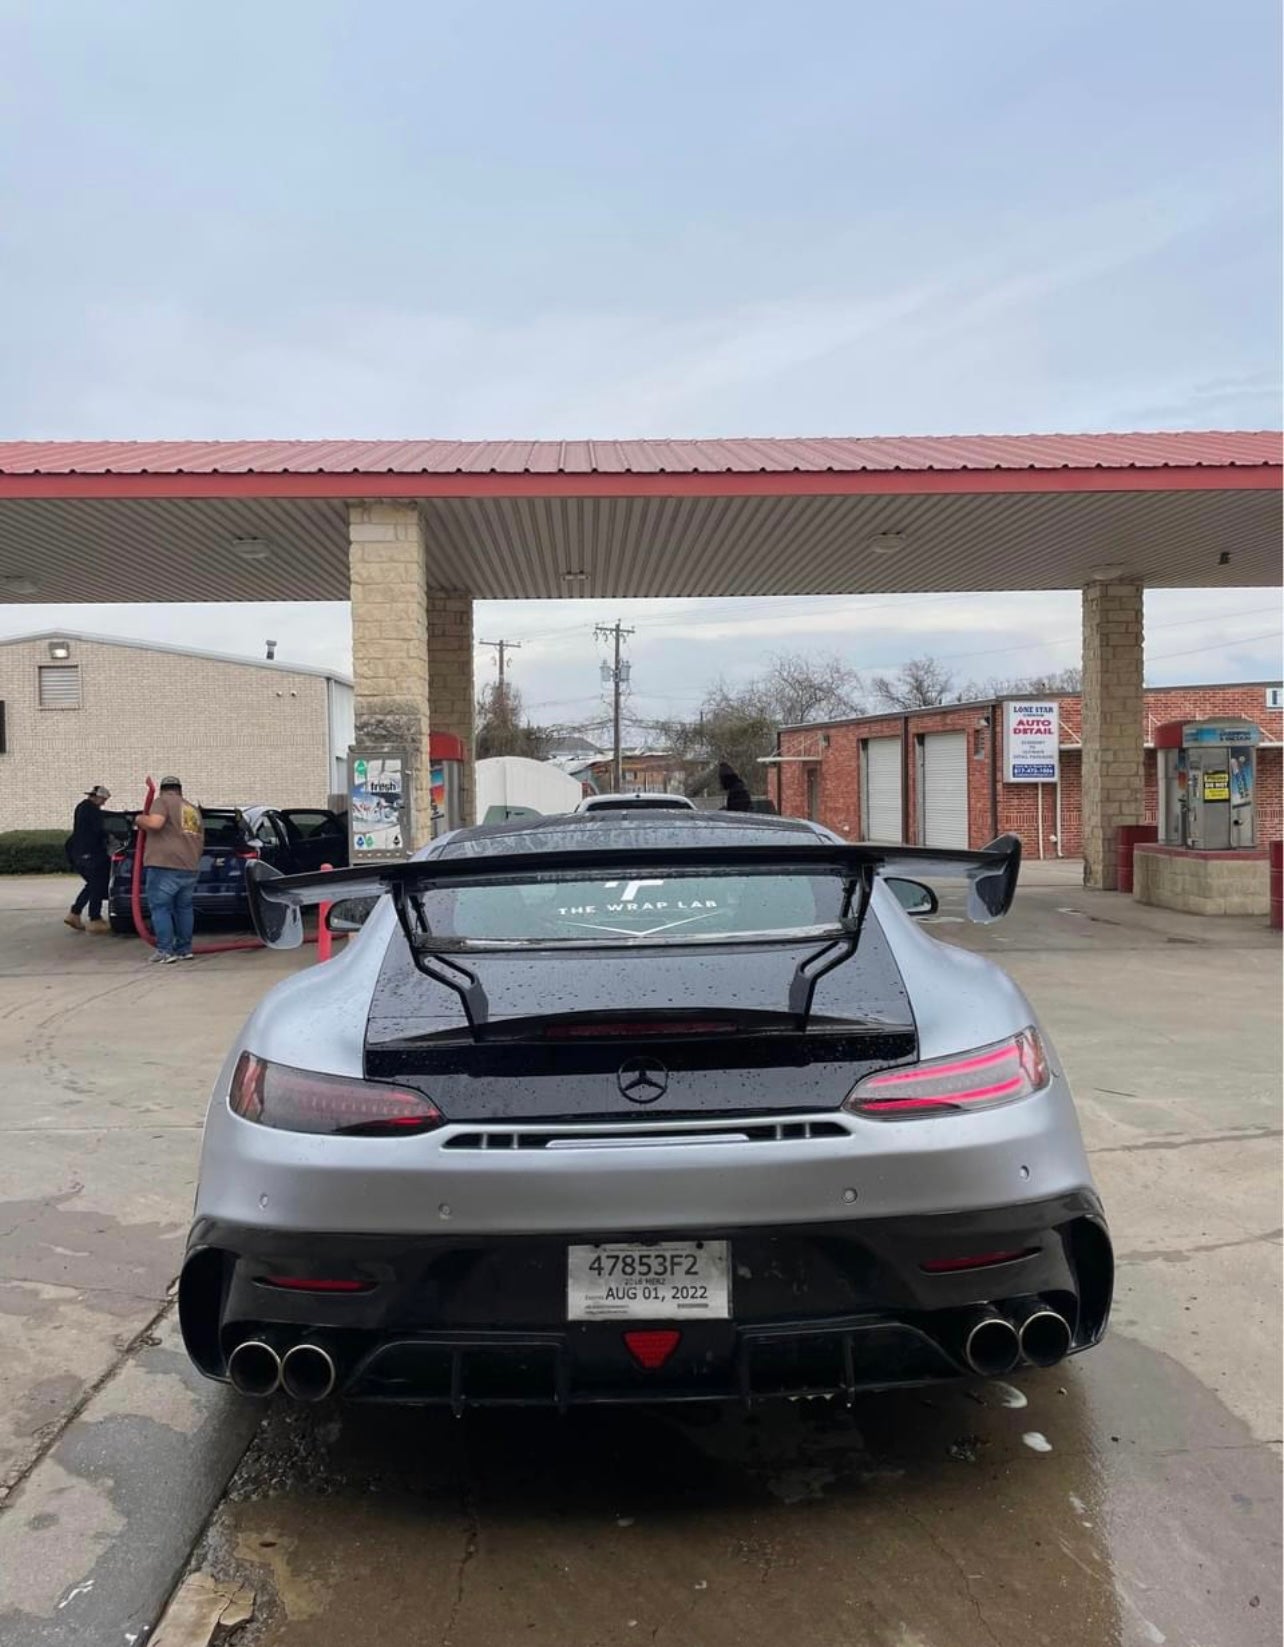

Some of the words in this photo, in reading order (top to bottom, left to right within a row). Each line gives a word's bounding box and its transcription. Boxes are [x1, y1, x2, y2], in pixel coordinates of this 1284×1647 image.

[371, 782, 397, 791] fresh
[558, 906, 596, 915] THE
[607, 901, 668, 911] WRAP
[677, 899, 718, 909] LAB
[588, 1254, 699, 1276] 47853F2
[605, 1286, 638, 1301] AUG
[642, 1285, 666, 1303] 01,
[671, 1285, 708, 1300] 2022
